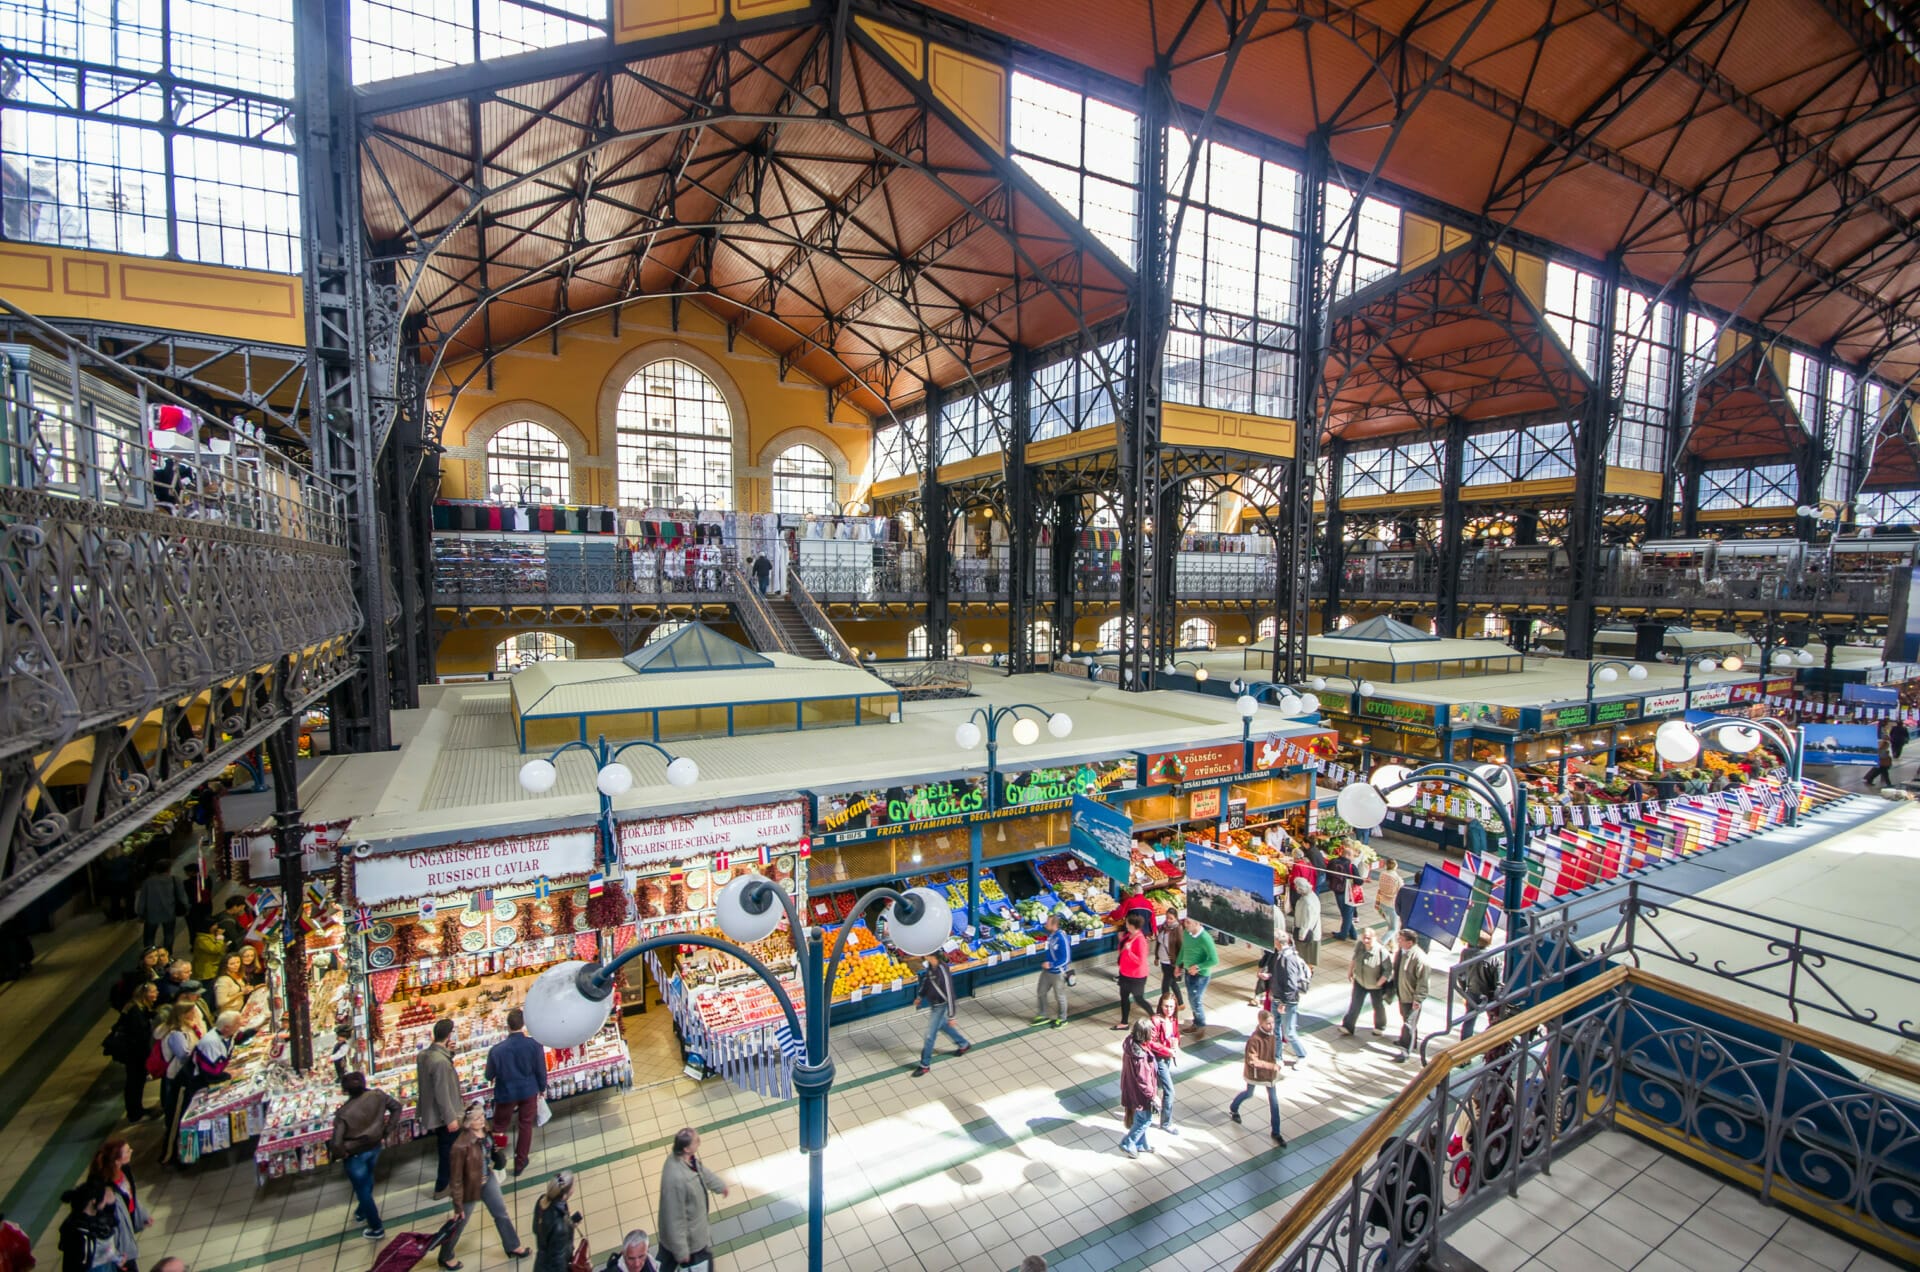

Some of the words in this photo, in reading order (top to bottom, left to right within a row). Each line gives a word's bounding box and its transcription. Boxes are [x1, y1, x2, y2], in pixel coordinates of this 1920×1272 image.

[916, 784, 960, 801] DÉLI-
[1005, 774, 1087, 805] GYÜMÖLCS
[824, 792, 878, 832] Narancs
[888, 789, 983, 823] GYÜMÖLCS
[713, 808, 773, 827] UNGARISCHER
[622, 823, 665, 840] TOKAJER
[671, 819, 695, 833] WEIN
[757, 823, 791, 837] SAFRAN
[409, 848, 490, 869] UNGARISCHE
[428, 866, 490, 886] RUSSISCH
[495, 858, 540, 876] CAVIAR
